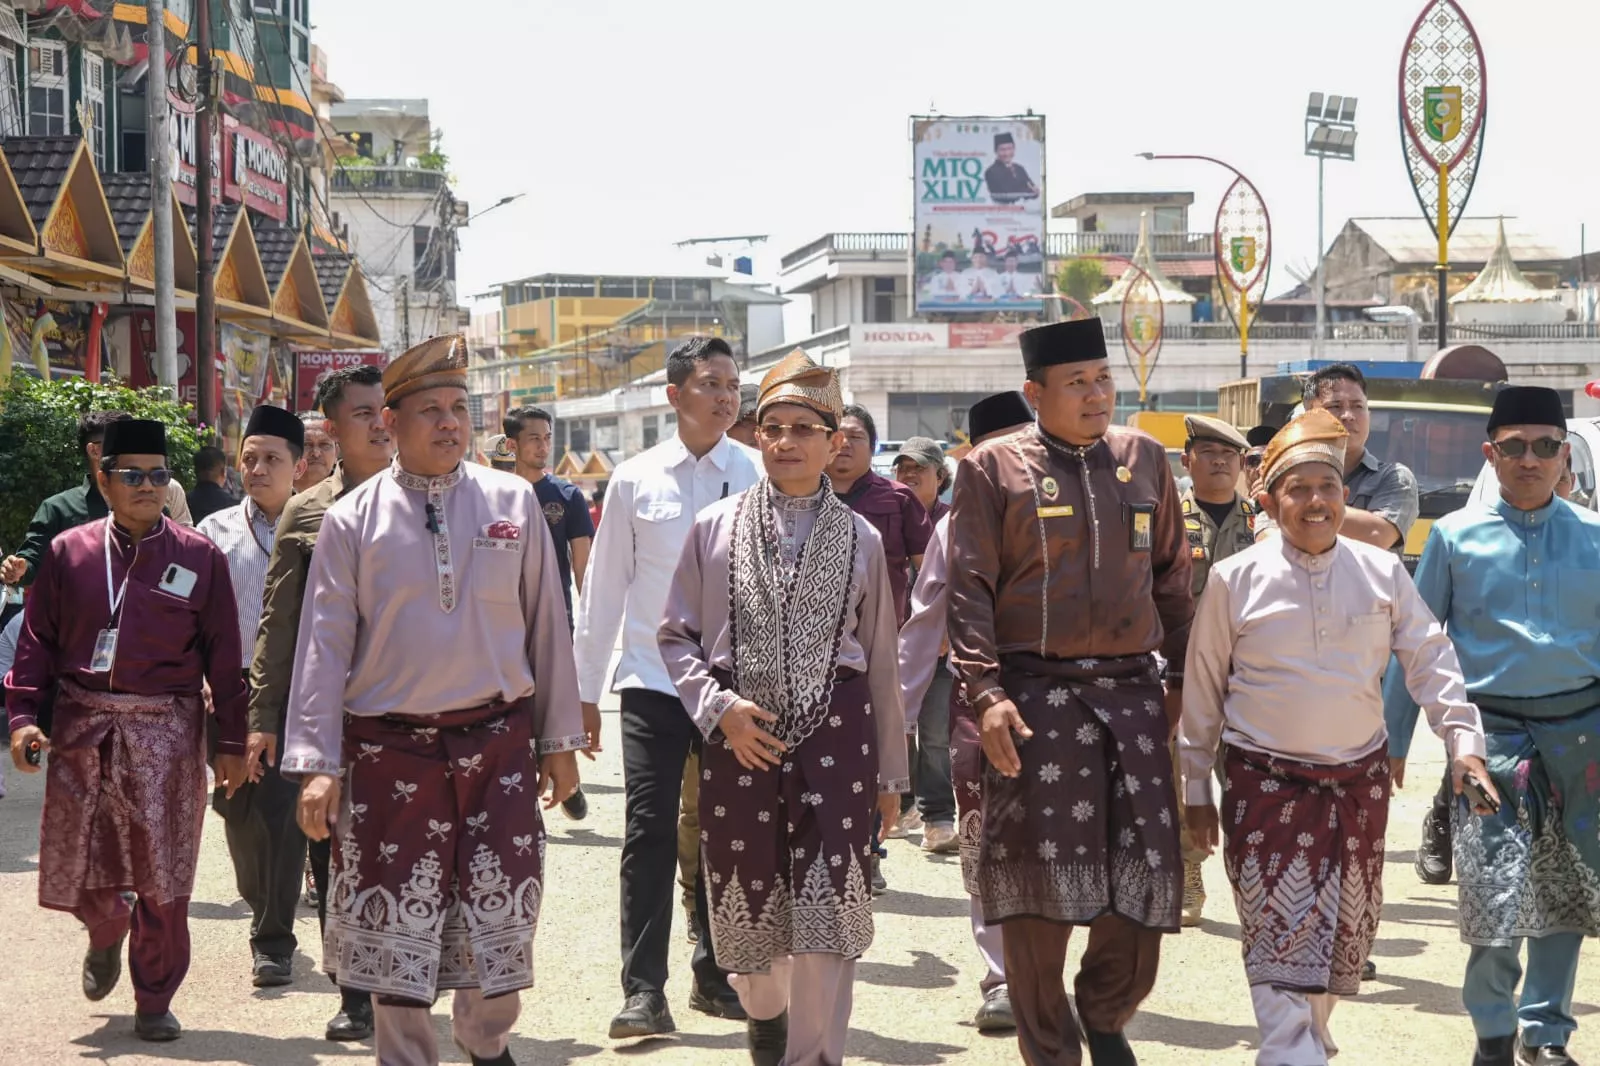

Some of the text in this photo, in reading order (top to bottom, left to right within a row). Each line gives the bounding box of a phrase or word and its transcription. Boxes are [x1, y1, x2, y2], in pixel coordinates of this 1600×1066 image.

[248, 138, 287, 184] MOMOYO
[922, 158, 984, 179] MTQ
[923, 180, 983, 199] XLIV
[864, 332, 934, 342] HONDA
